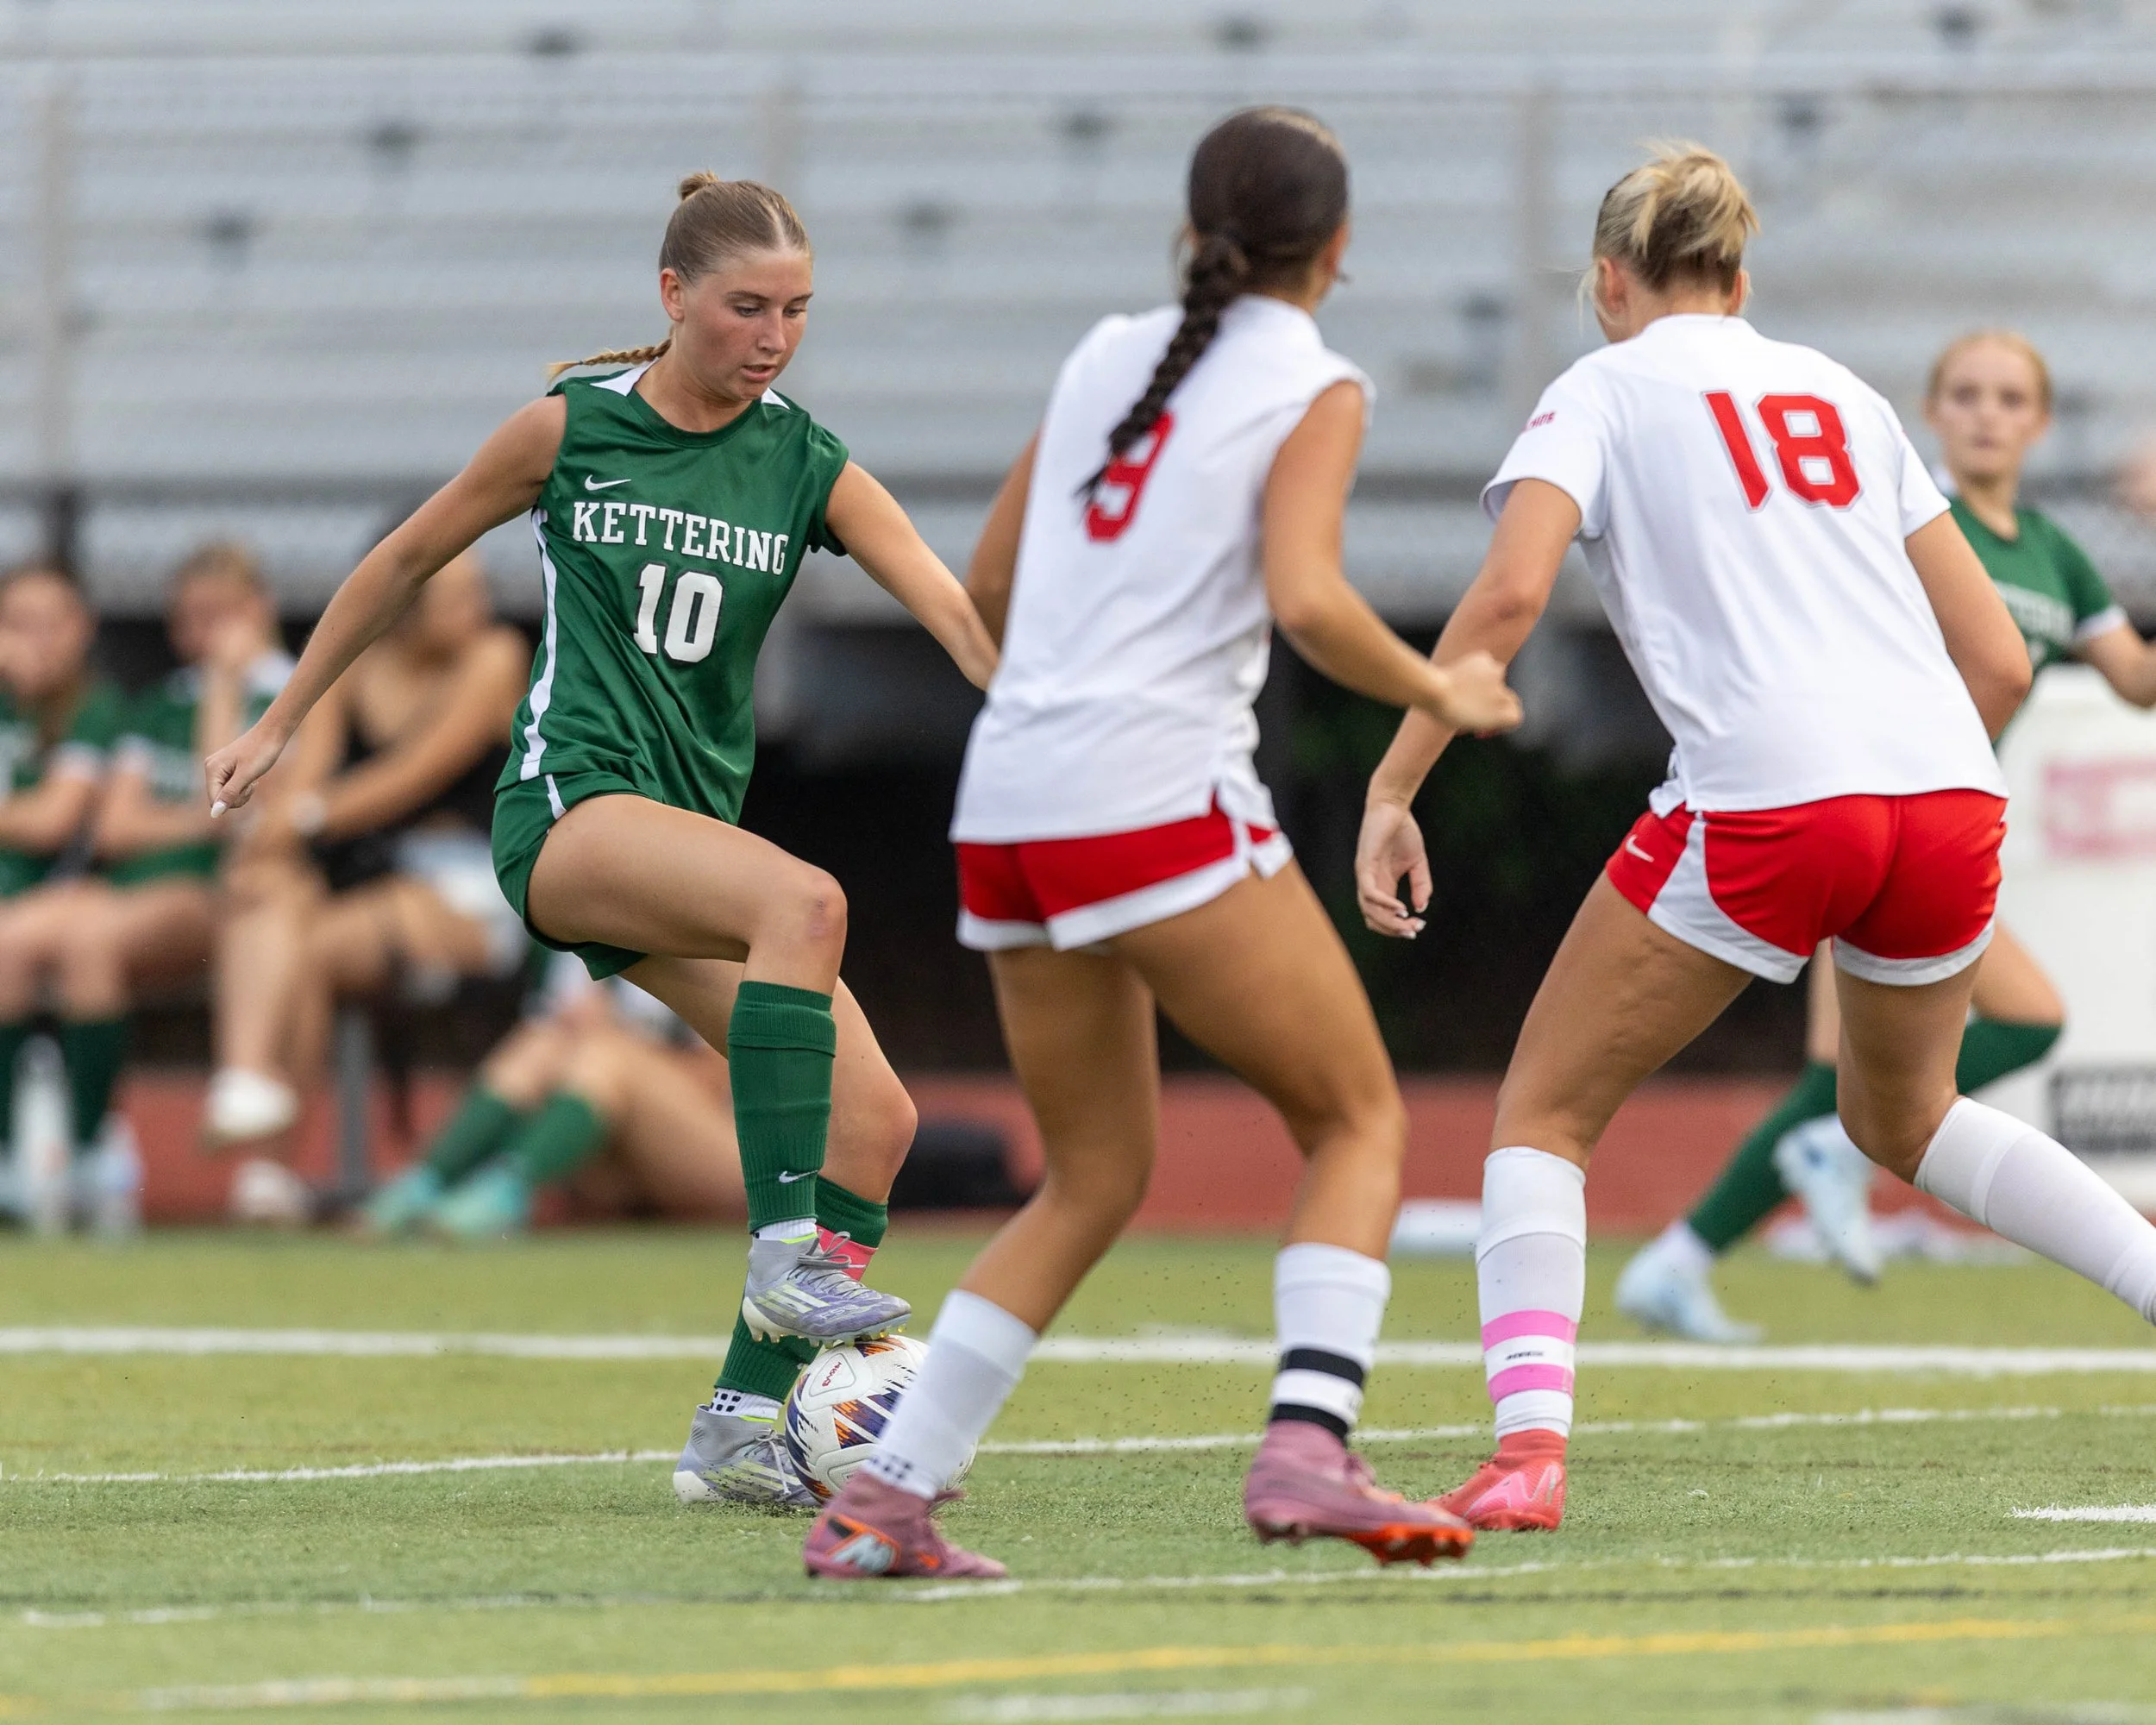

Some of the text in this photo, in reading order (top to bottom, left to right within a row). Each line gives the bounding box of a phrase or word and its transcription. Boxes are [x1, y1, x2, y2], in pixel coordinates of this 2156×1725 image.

[1087, 409, 1175, 543] 9
[1701, 389, 1862, 511] 18
[572, 501, 789, 575] KETTERING
[632, 562, 724, 663] 10
